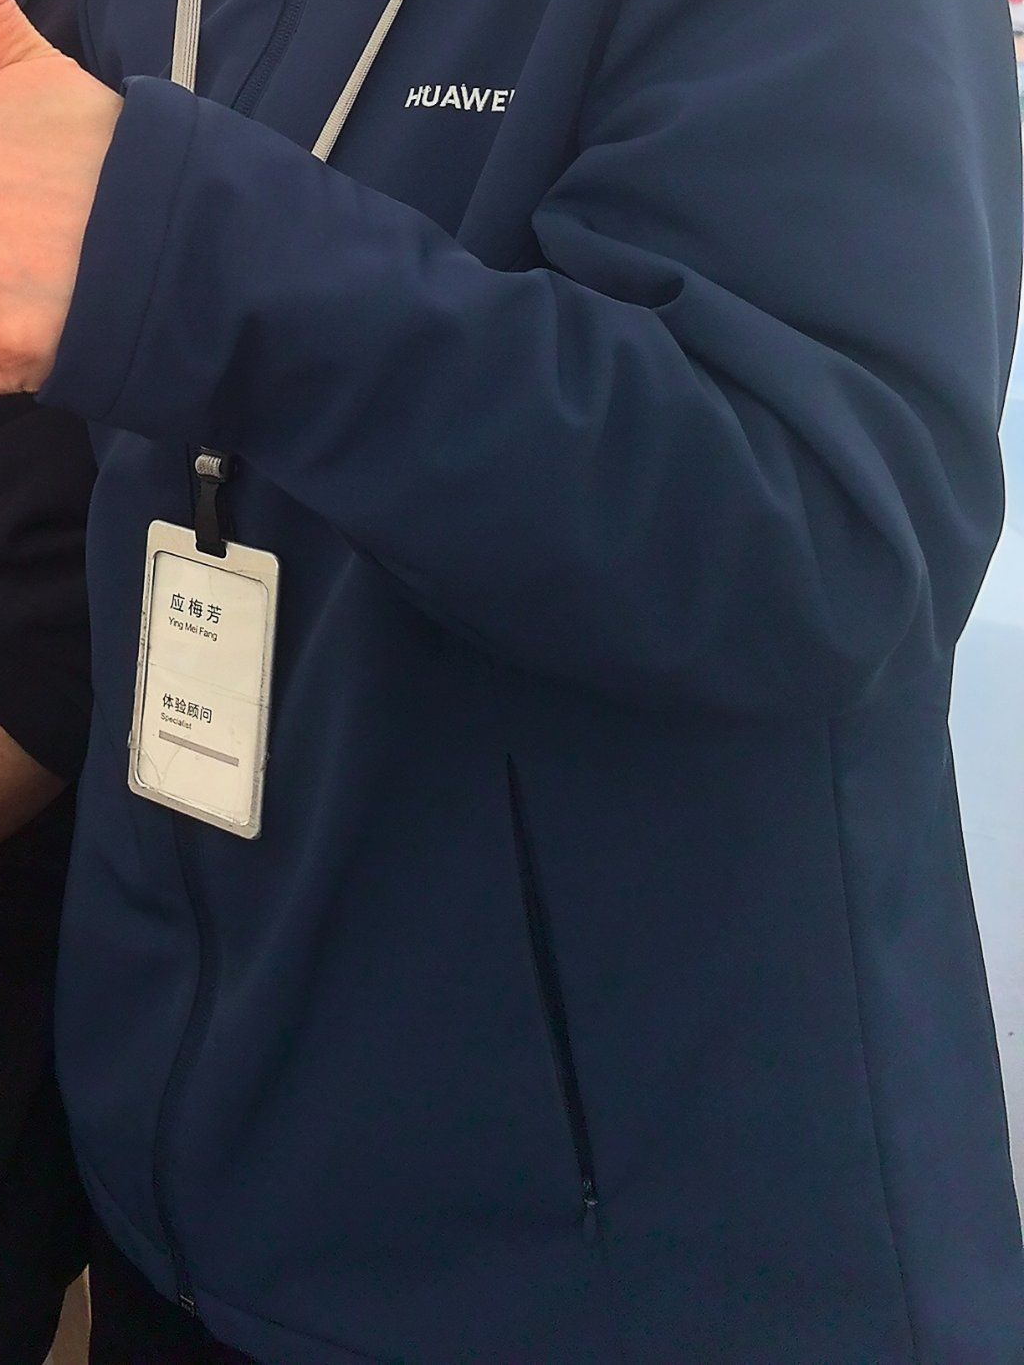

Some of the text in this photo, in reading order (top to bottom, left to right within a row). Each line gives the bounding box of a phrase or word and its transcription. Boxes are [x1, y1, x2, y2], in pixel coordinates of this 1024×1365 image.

[170, 593, 222, 624] 应梅芳
[168, 616, 218, 642] Ying Mei Fang
[160, 712, 192, 730] Specialist
[163, 693, 212, 723] 体验顾问
